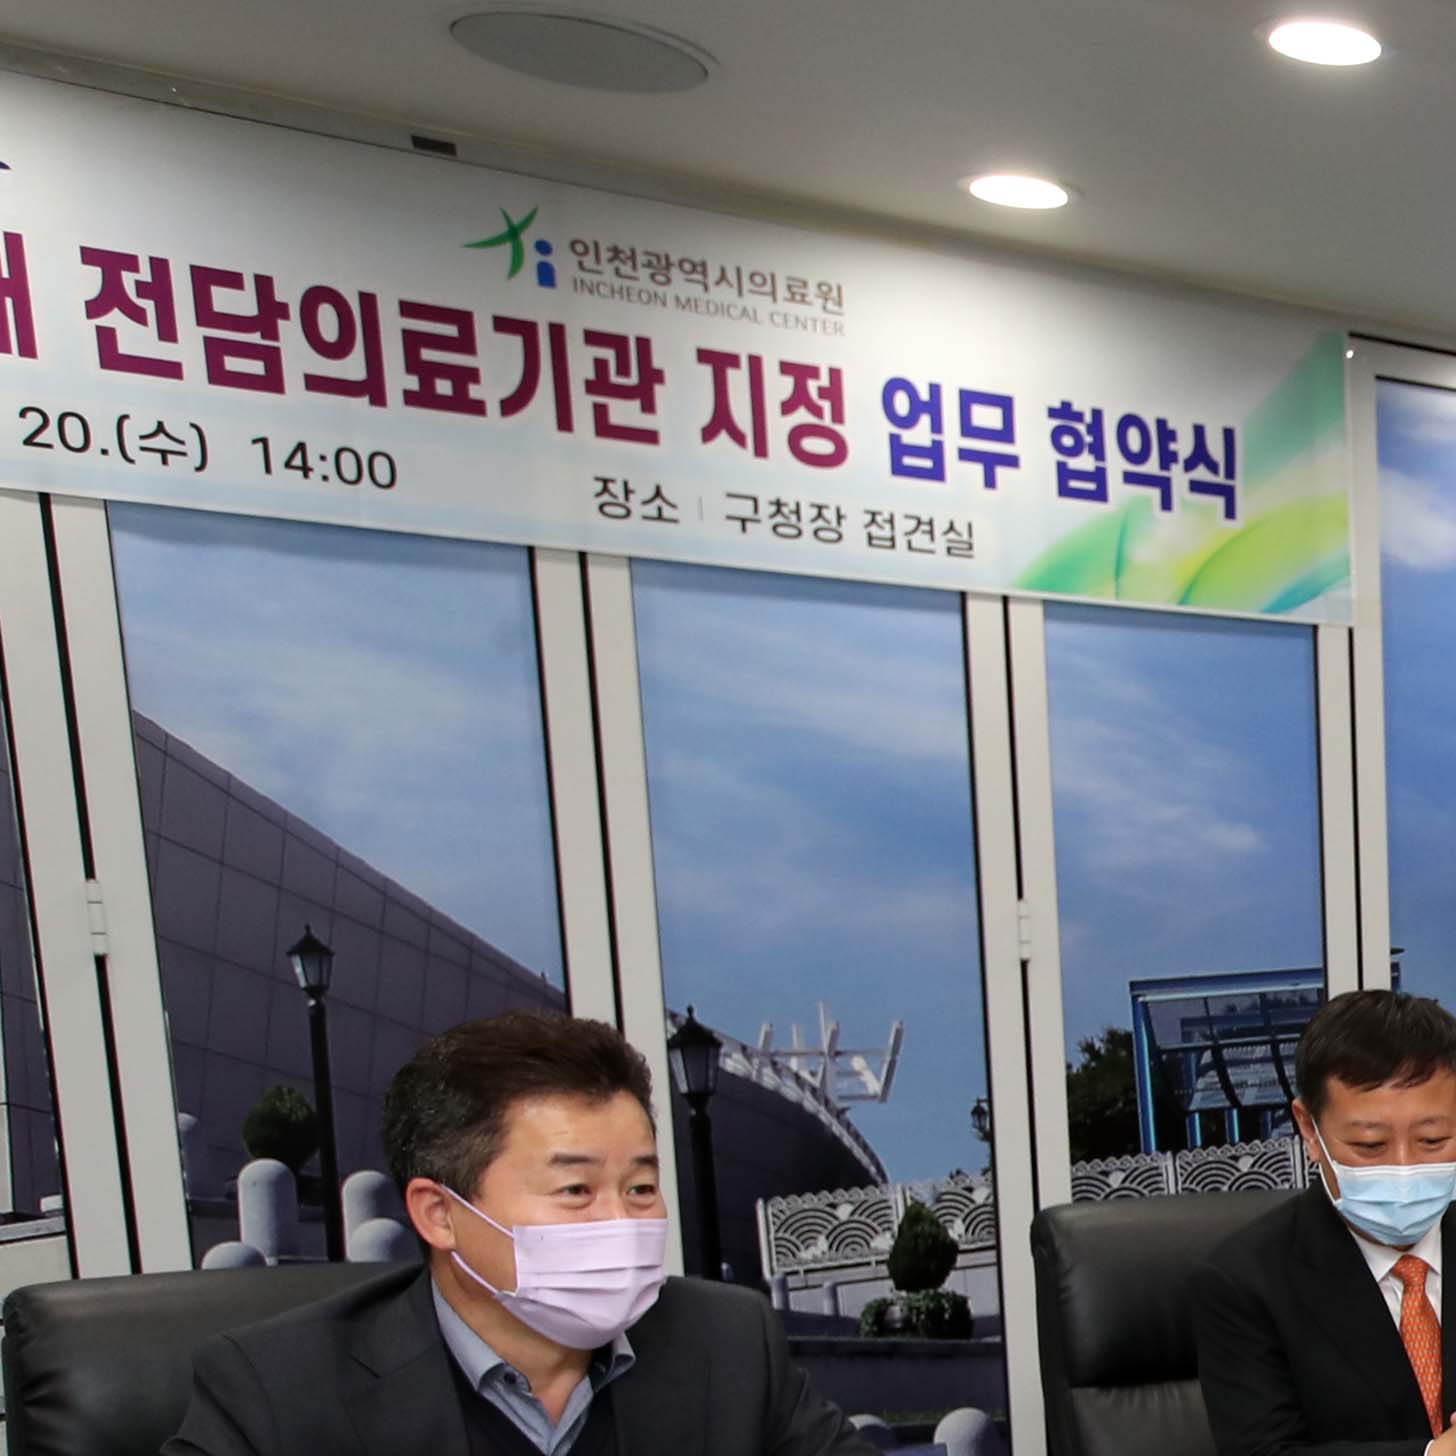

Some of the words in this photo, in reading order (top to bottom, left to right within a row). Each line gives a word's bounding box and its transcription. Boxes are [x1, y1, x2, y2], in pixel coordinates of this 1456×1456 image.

[570, 238, 845, 316] 인천광역시의료원
[573, 277, 667, 309] INCHEON
[675, 295, 761, 325] MEDICAL
[769, 311, 845, 337] CENTER
[80, 245, 665, 446] 전담의료기관
[697, 346, 850, 469] 지정
[882, 376, 1021, 491] 업무
[1047, 400, 1238, 521] 협약식
[18, 407, 208, 472] 20.(수)
[251, 437, 398, 490] 14:00
[593, 475, 680, 526] 장소
[725, 492, 847, 545] 구청장
[864, 511, 976, 560] 접견실
